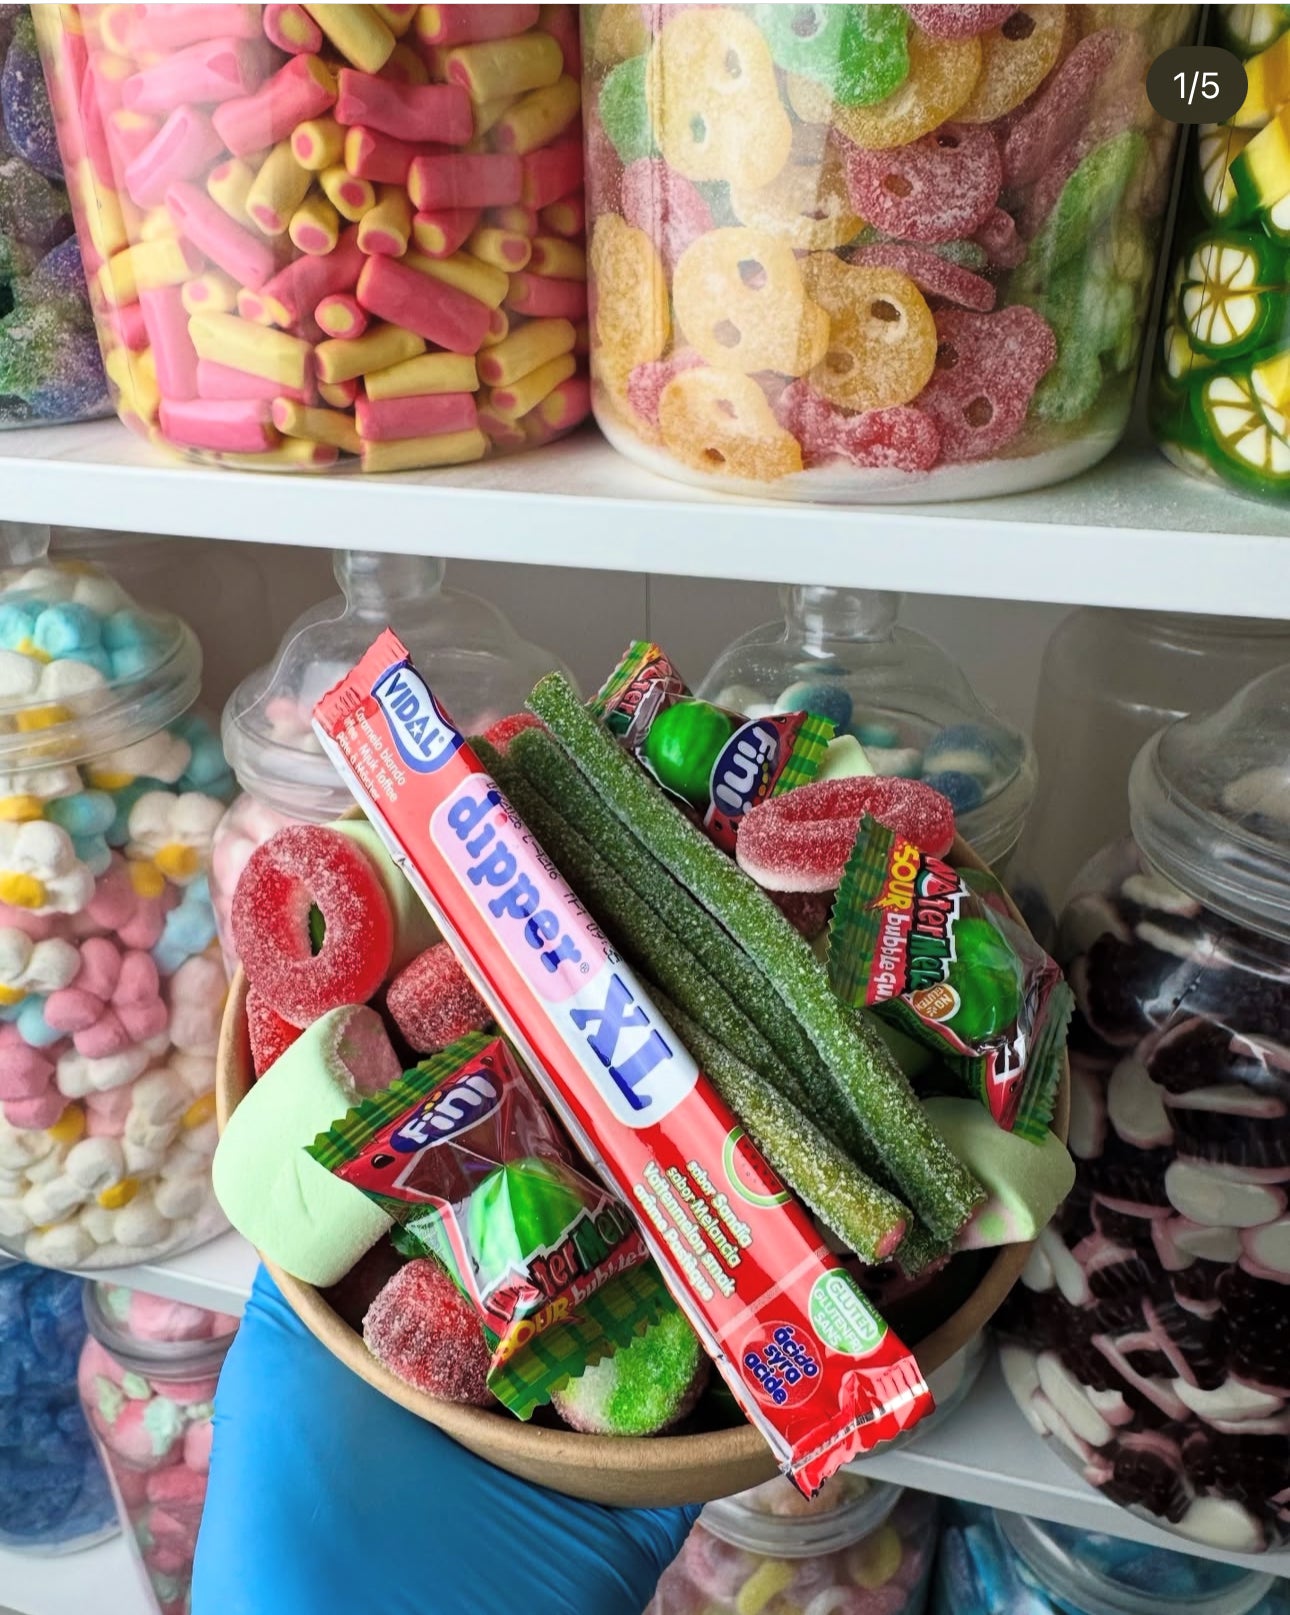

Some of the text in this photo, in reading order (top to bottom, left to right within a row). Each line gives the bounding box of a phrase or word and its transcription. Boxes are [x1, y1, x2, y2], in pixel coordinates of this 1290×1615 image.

[355, 706, 406, 786] Caramelo blando
[385, 673, 440, 758] VIDAL
[359, 742, 380, 772] Mjuk
[376, 767, 398, 802] Toffee
[448, 790, 582, 973] dipper
[885, 845, 920, 911] SOUR
[915, 986, 945, 1011] GLUTEN
[936, 994, 953, 1011] NO
[569, 973, 674, 1111] XL
[397, 1075, 497, 1144] Fini
[643, 1160, 737, 1298] Vattenmelon smak
[665, 1167, 742, 1269] sabor Melancia
[686, 1160, 753, 1248] sabor Sandía
[813, 1311, 842, 1347] SANS
[814, 1288, 863, 1351] GLUTENFRI
[829, 1281, 876, 1339] GLUTEN
[744, 1352, 787, 1405] acide
[763, 1344, 802, 1385] syra
[774, 1326, 818, 1377] ácido
